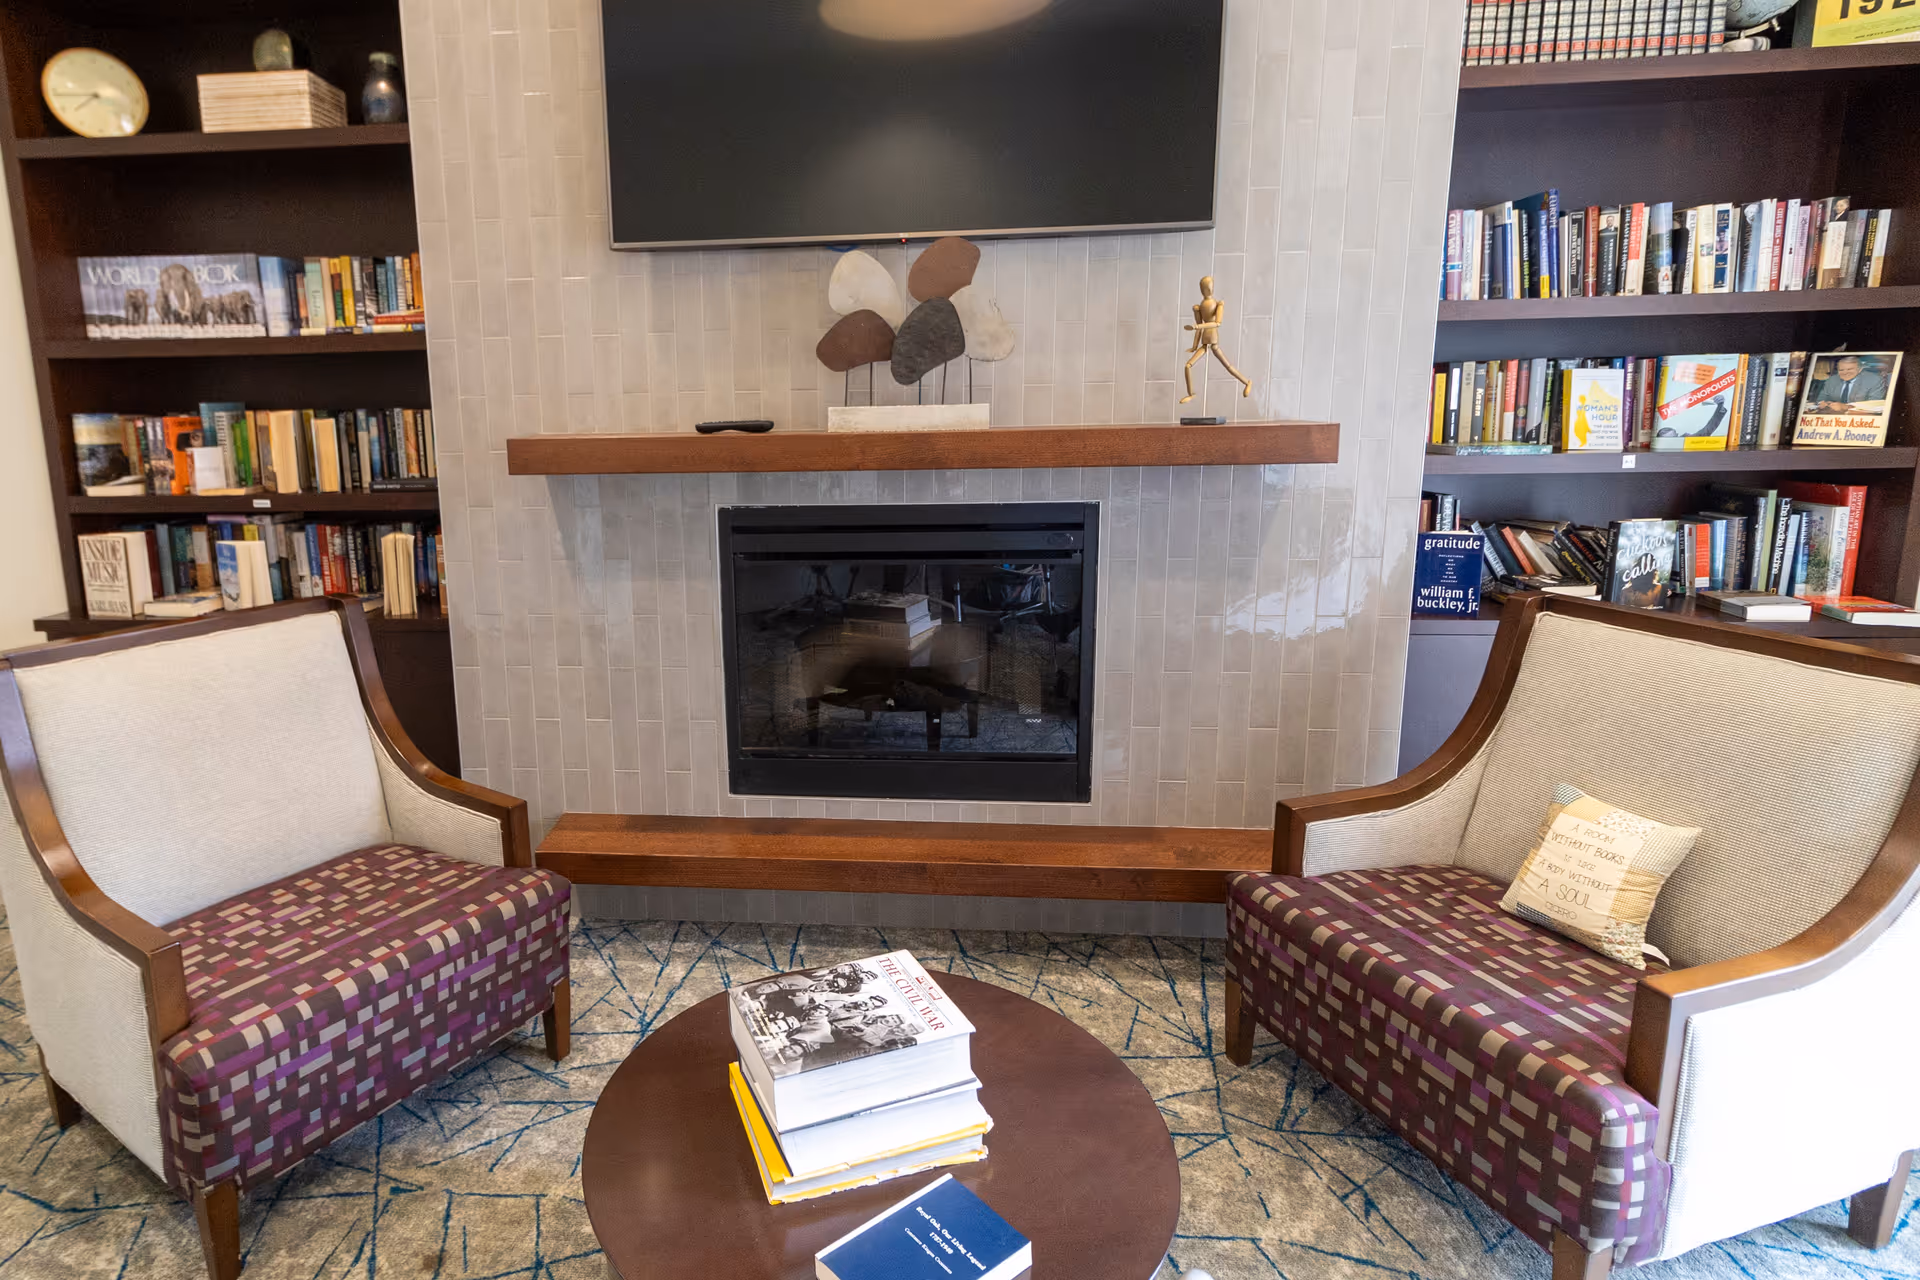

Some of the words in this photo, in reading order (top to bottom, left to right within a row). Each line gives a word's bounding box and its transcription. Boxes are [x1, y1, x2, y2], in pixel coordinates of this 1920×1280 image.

[1549, 195, 1558, 229] EUROPE
[1475, 388, 1484, 417] Kazan
[1680, 374, 1736, 407] MONOPOLISTS
[1576, 404, 1618, 412] WOMAN'S
[1797, 428, 1832, 441] Andrew
[1832, 429, 1843, 440] A.
[1844, 430, 1878, 444] Rooney
[1799, 416, 1814, 428] Not
[1815, 417, 1833, 428] That
[1834, 417, 1850, 429] You
[1442, 498, 1452, 531] LOUVR
[1780, 504, 1791, 516] The
[1424, 537, 1480, 550] gratitude
[1776, 517, 1788, 546] Incredible
[1772, 547, 1784, 574] Machine
[1421, 586, 1463, 598] william
[1468, 588, 1475, 599] f.
[1467, 599, 1478, 613] jr.
[1572, 824, 1580, 833] A
[1584, 829, 1615, 844] ROOM
[1551, 832, 1593, 853] WITHOUT
[1594, 847, 1625, 865] BOOKS
[1546, 862, 1565, 876] BODY
[1568, 869, 1613, 893] WITHOUT
[1577, 860, 1596, 871] LIKE
[1538, 878, 1549, 894] A
[1556, 884, 1594, 911] SOUL
[1544, 901, 1578, 920] CICERO
[879, 956, 901, 979] THE
[896, 976, 923, 1006] CIVIL
[919, 1005, 944, 1032] WAR
[915, 1206, 931, 1220] Royal
[941, 1229, 952, 1239] Our
[950, 1238, 967, 1254] Living
[965, 1252, 986, 1271] Legend
